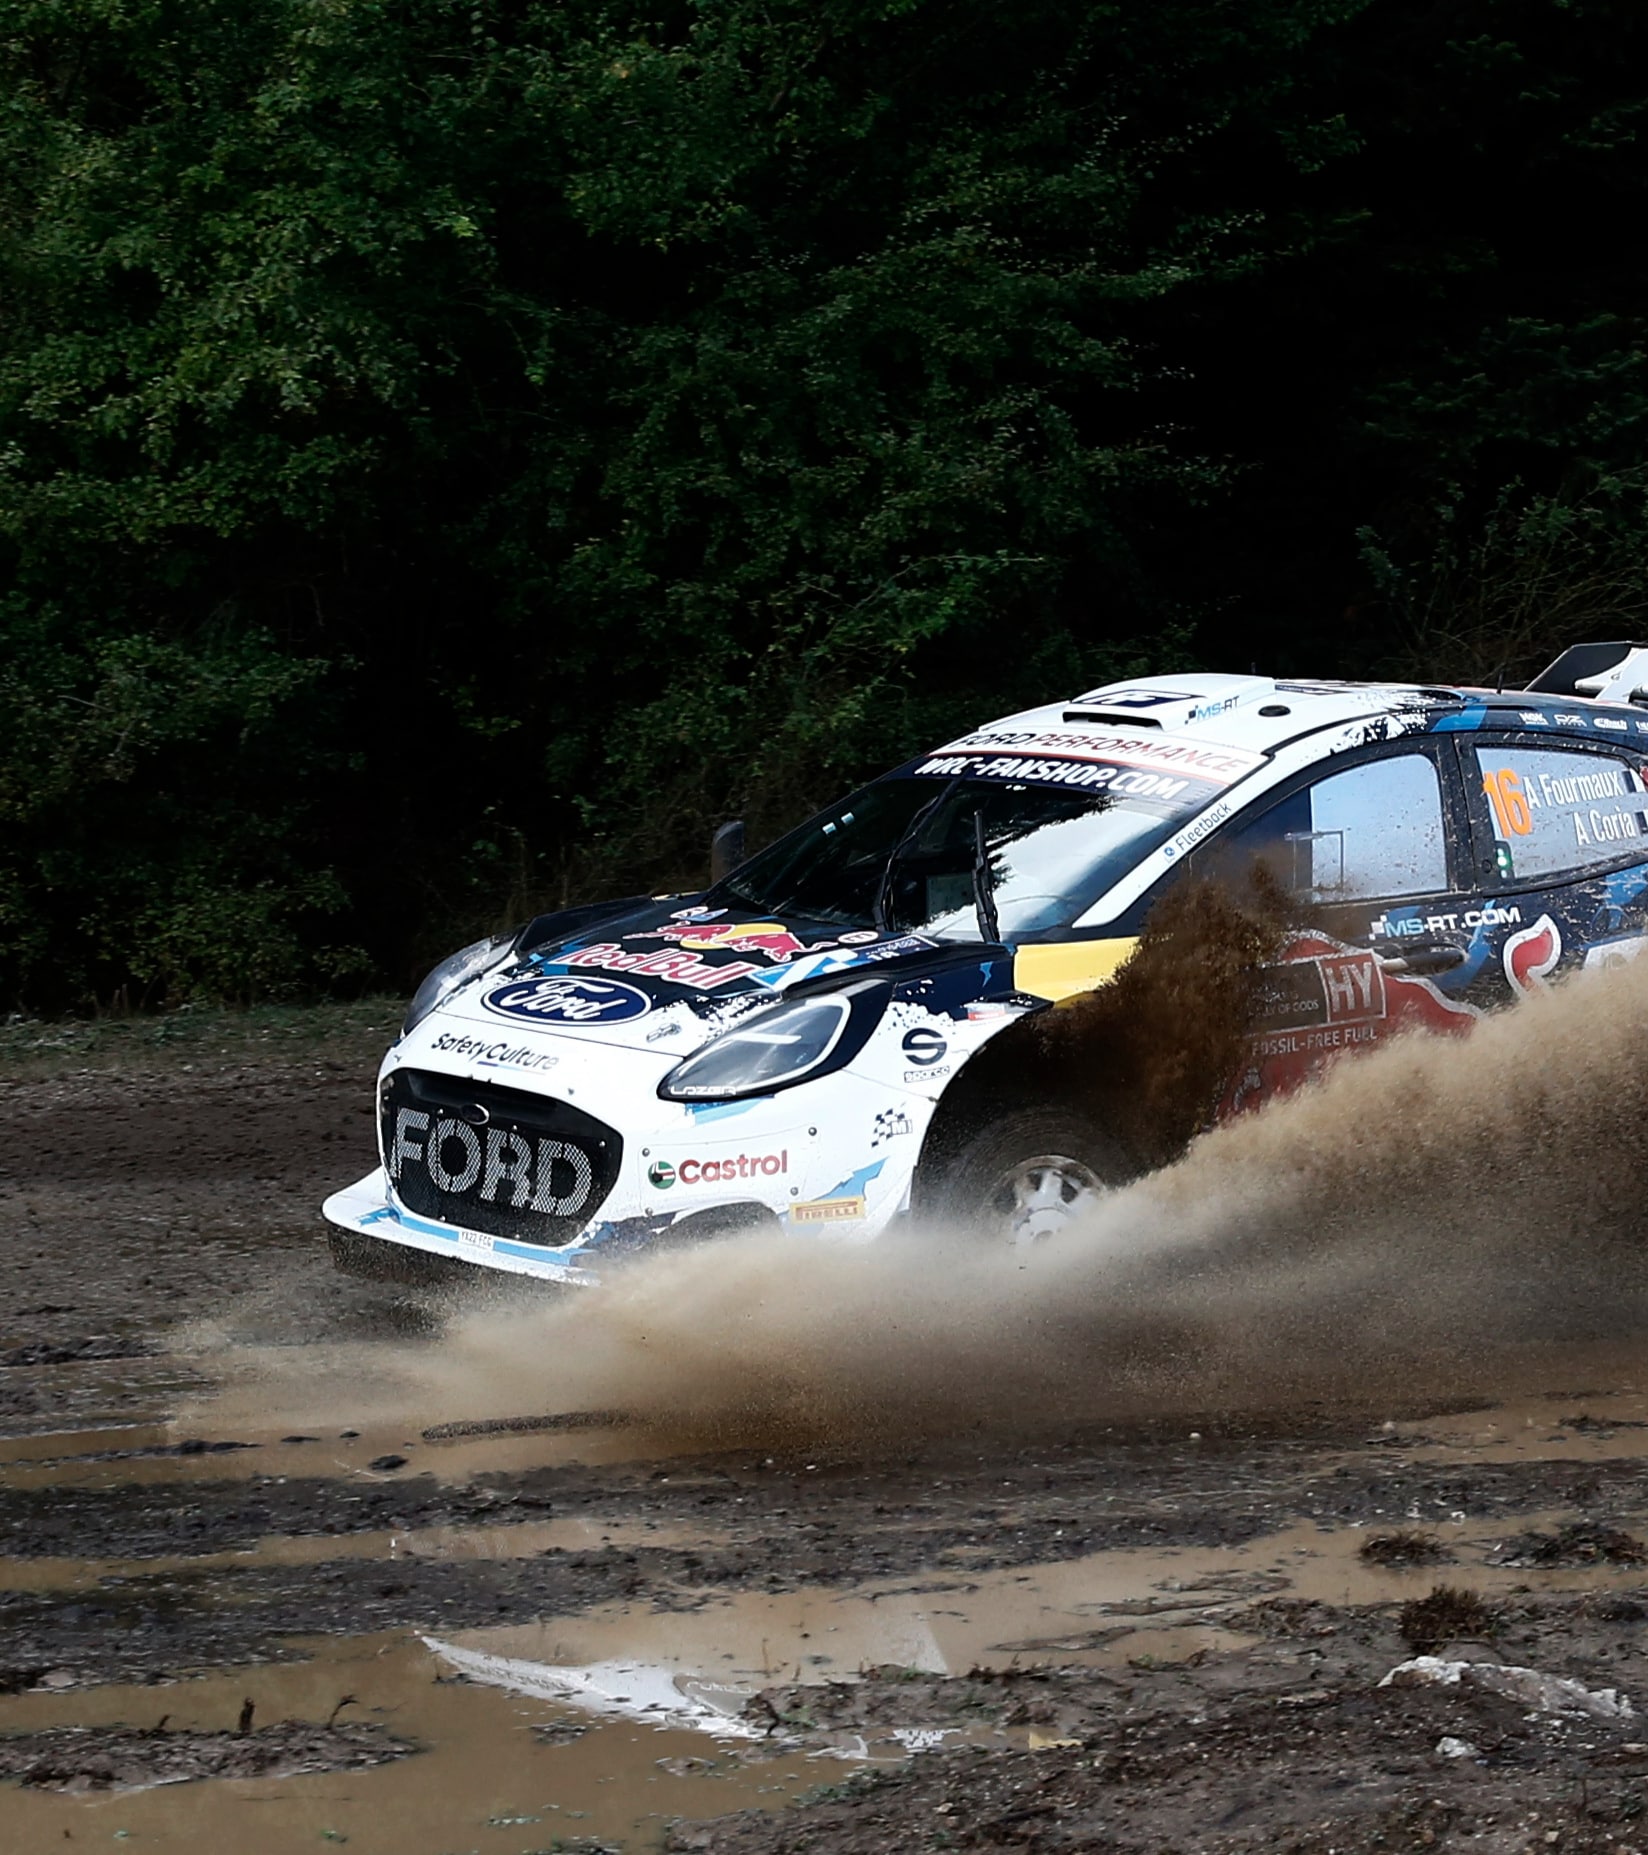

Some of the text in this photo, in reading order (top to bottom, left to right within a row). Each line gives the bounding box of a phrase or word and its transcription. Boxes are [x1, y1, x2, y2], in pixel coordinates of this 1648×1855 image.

[914, 757, 1190, 800] WRC-FANSHOP.COM
[1522, 770, 1624, 810] A Fourmaux
[1482, 768, 1533, 838] 16
[1175, 801, 1232, 852] Fleetback
[1573, 805, 1636, 846] A Coria
[499, 978, 628, 1021] Ford
[1325, 961, 1373, 1013] HY
[431, 1032, 560, 1071] SafetyCulture
[390, 1107, 593, 1217] FORD
[678, 1149, 788, 1185] Castrol
